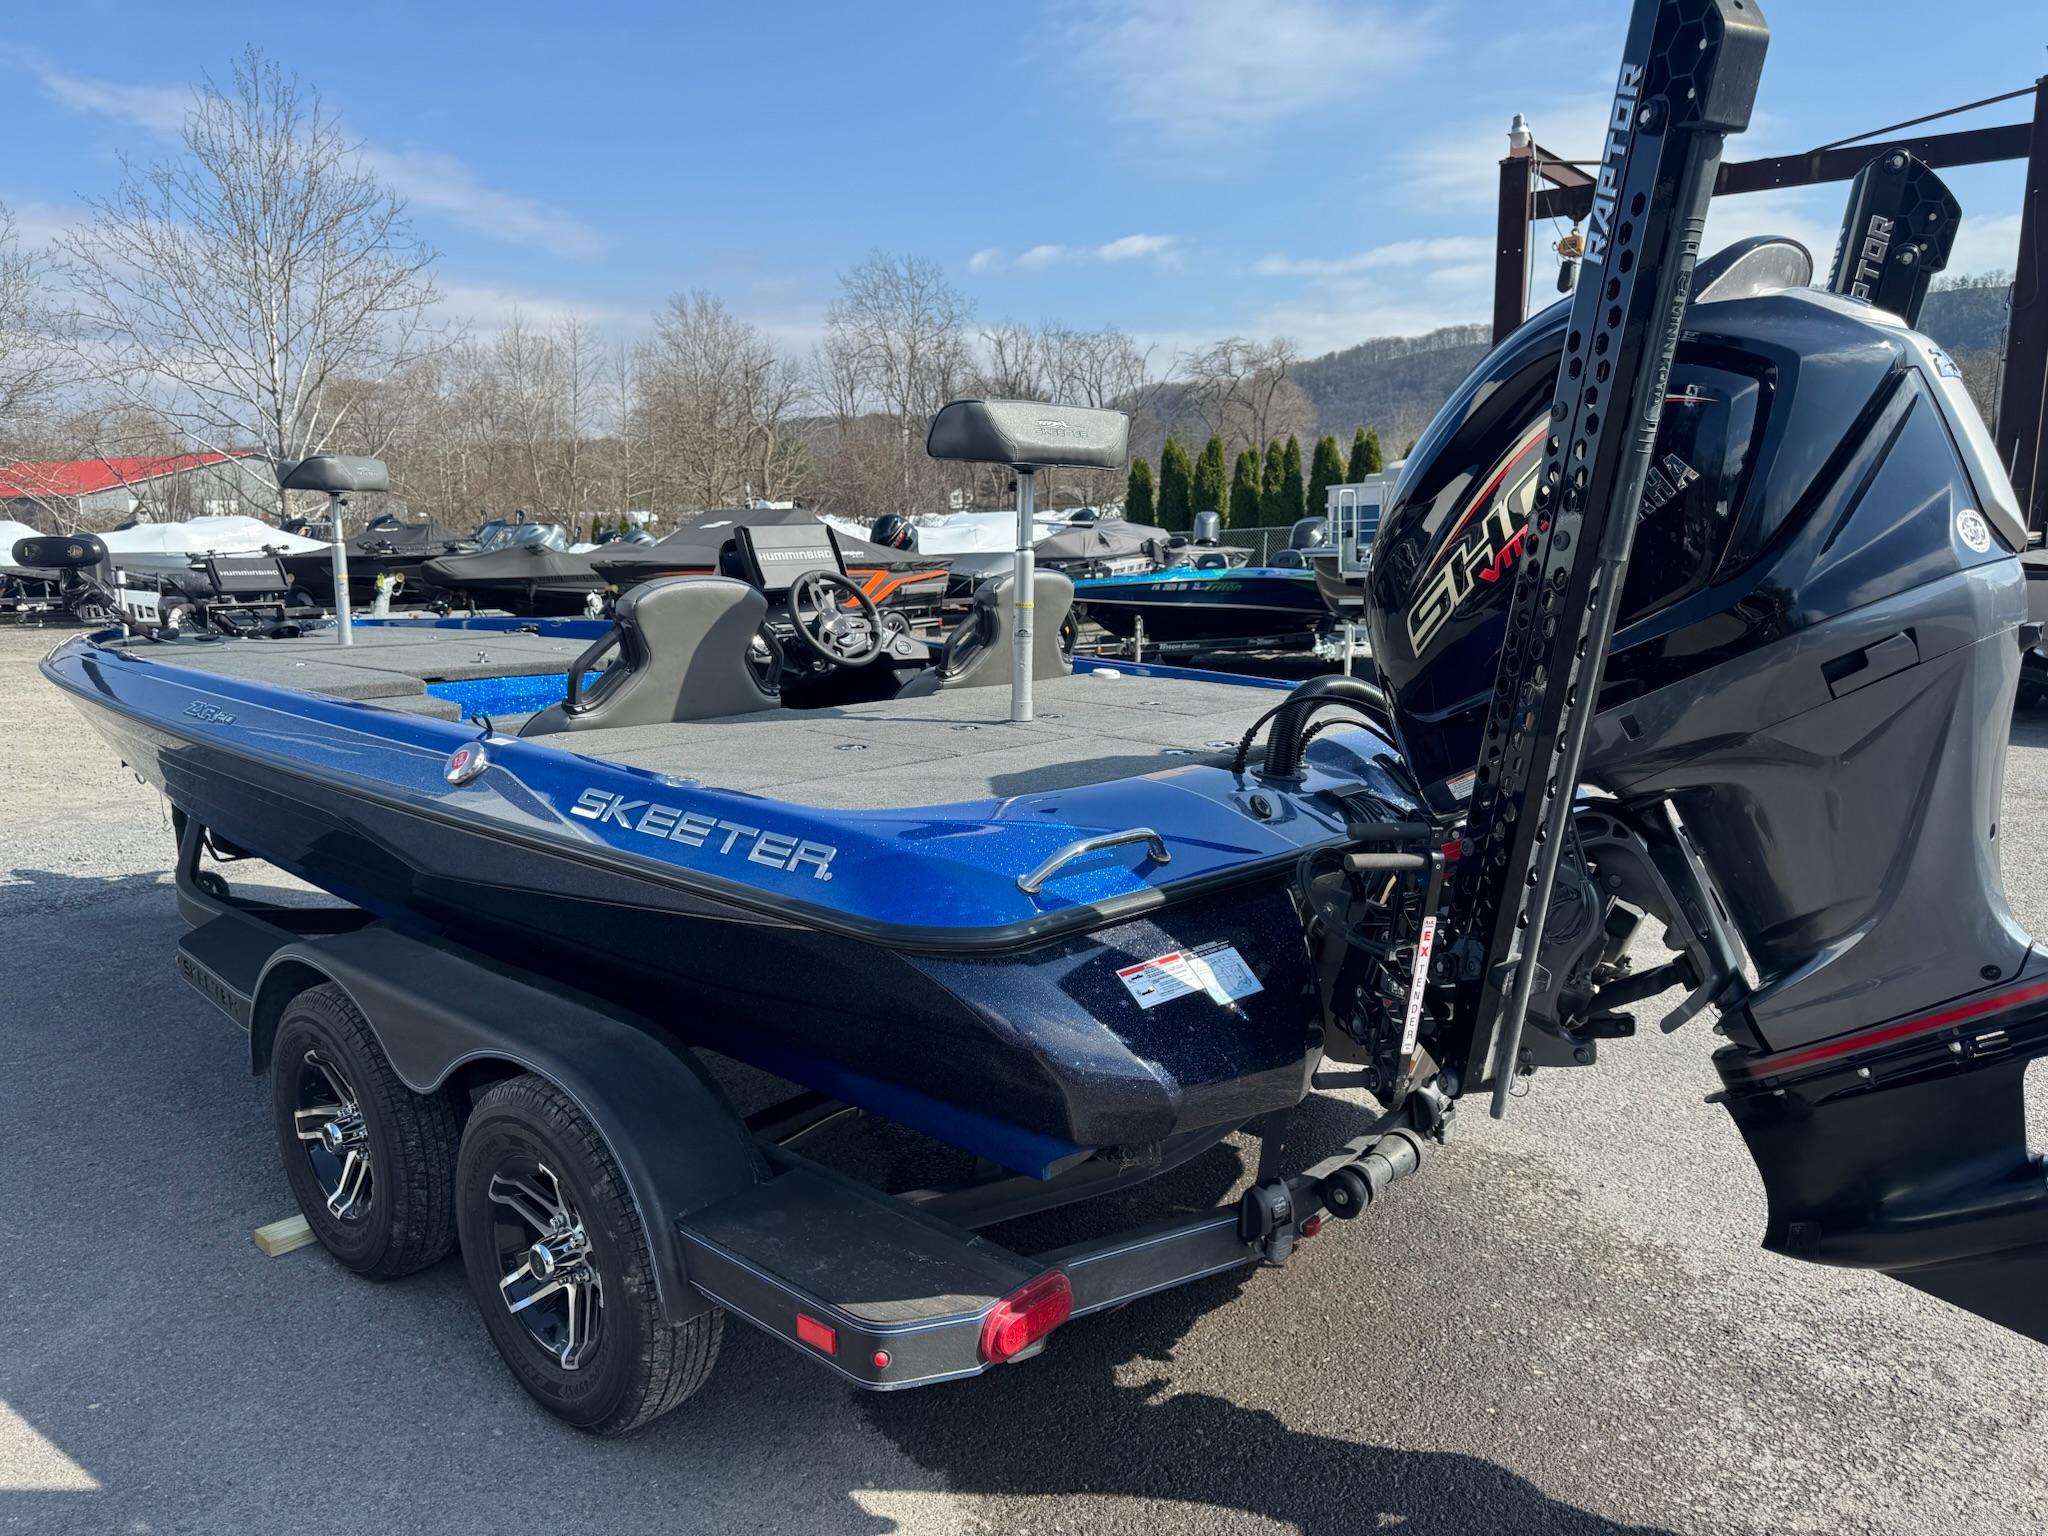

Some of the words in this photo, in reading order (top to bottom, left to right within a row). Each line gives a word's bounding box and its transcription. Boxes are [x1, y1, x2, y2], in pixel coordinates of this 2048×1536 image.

[1584, 63, 1644, 265] RAPTOR
[1850, 214, 1894, 303] PTOR
[757, 550, 833, 561] HUMMINBIRD
[1205, 581, 1243, 591] Triton
[570, 787, 837, 881] SKEETER
